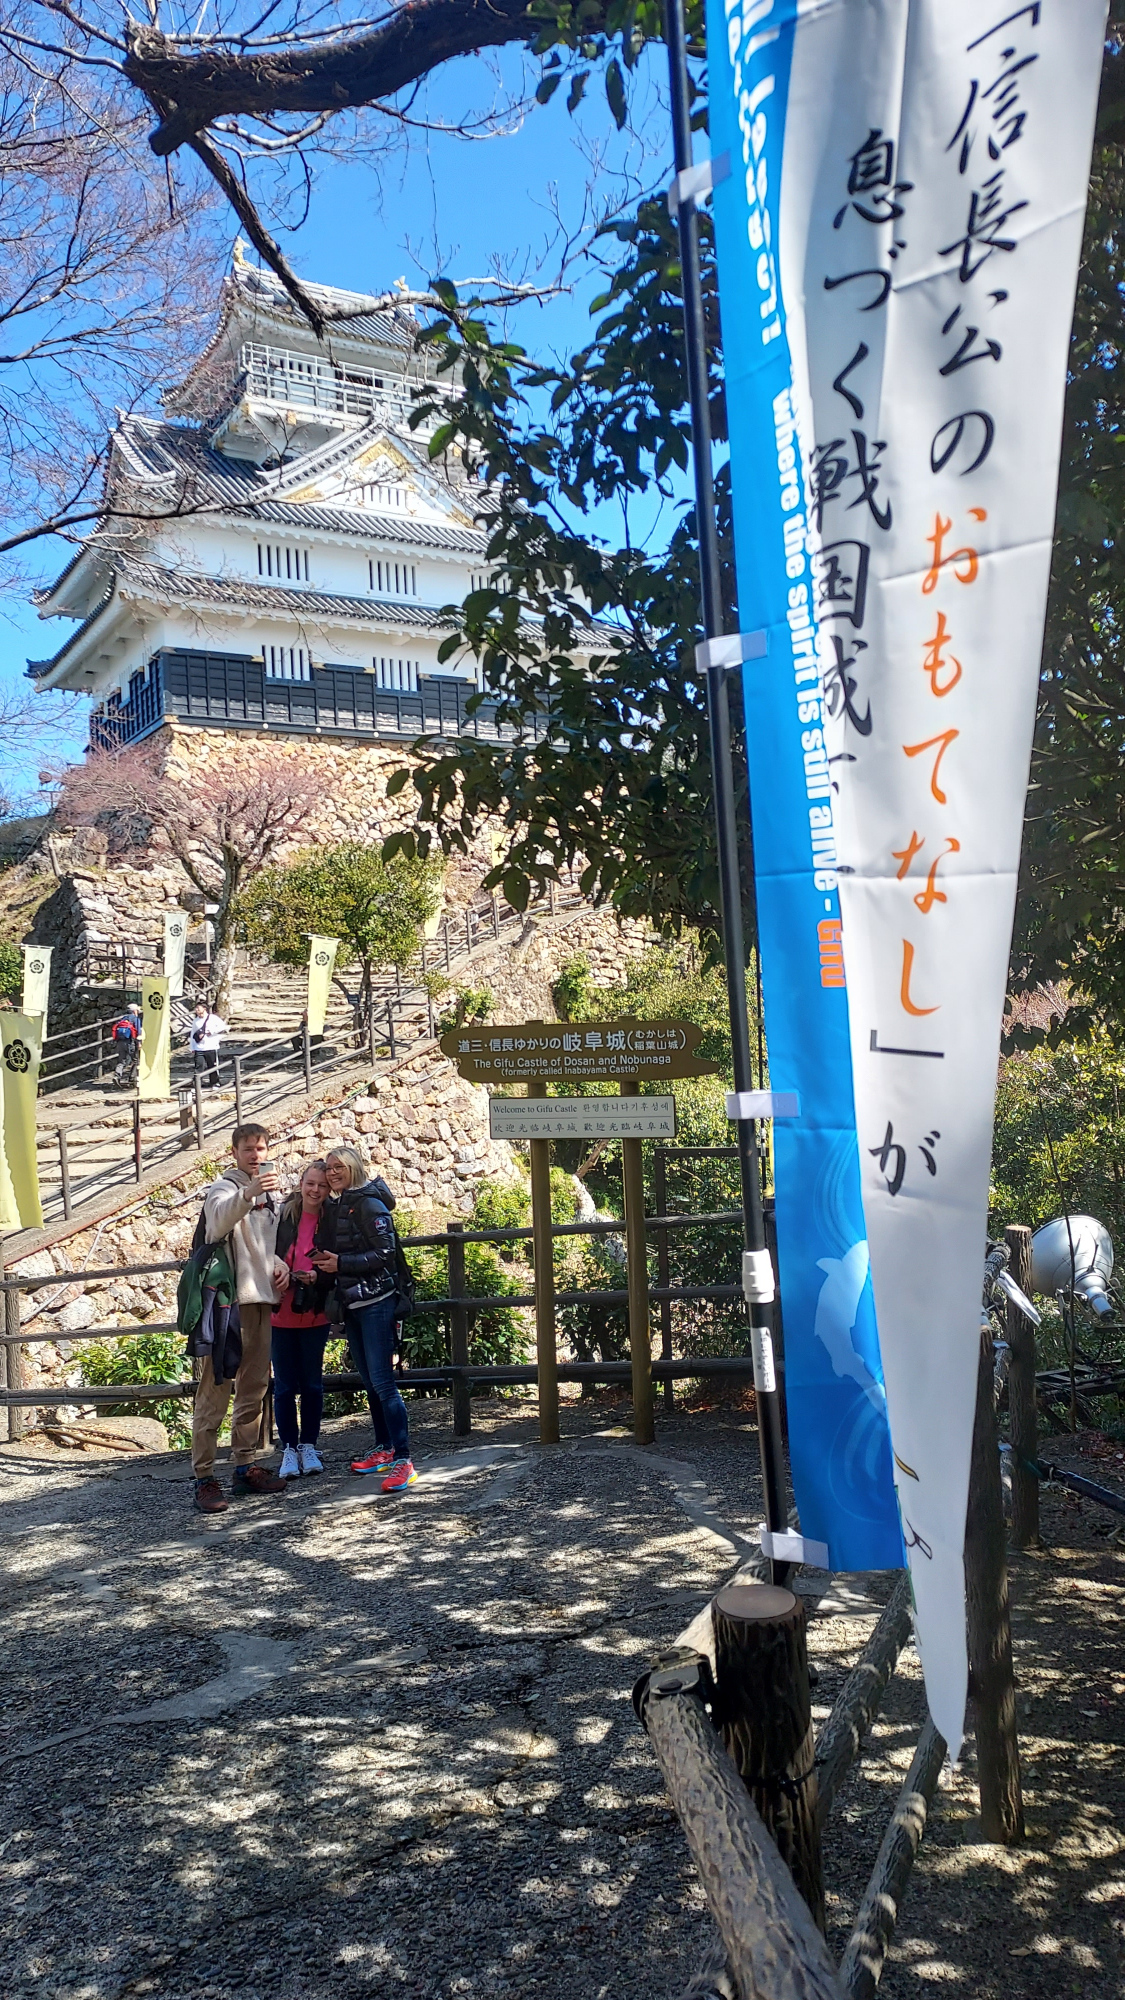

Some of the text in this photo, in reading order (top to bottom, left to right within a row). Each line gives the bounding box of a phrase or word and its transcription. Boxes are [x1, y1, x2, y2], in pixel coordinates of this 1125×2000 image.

[773, 386, 803, 511] where
[783, 512, 807, 579] the
[788, 582, 818, 686] spirit
[796, 688, 819, 724] is
[801, 728, 831, 799] still
[808, 805, 838, 892] alive
[473, 1055, 671, 1069] The Gifu Castle of Dosan and Nobunaga
[501, 1065, 639, 1078] (formerly called Inabayama Castle)
[493, 1105, 526, 1114] Welcome
[536, 1105, 553, 1113] Gifu
[554, 1105, 578, 1113] Castle
